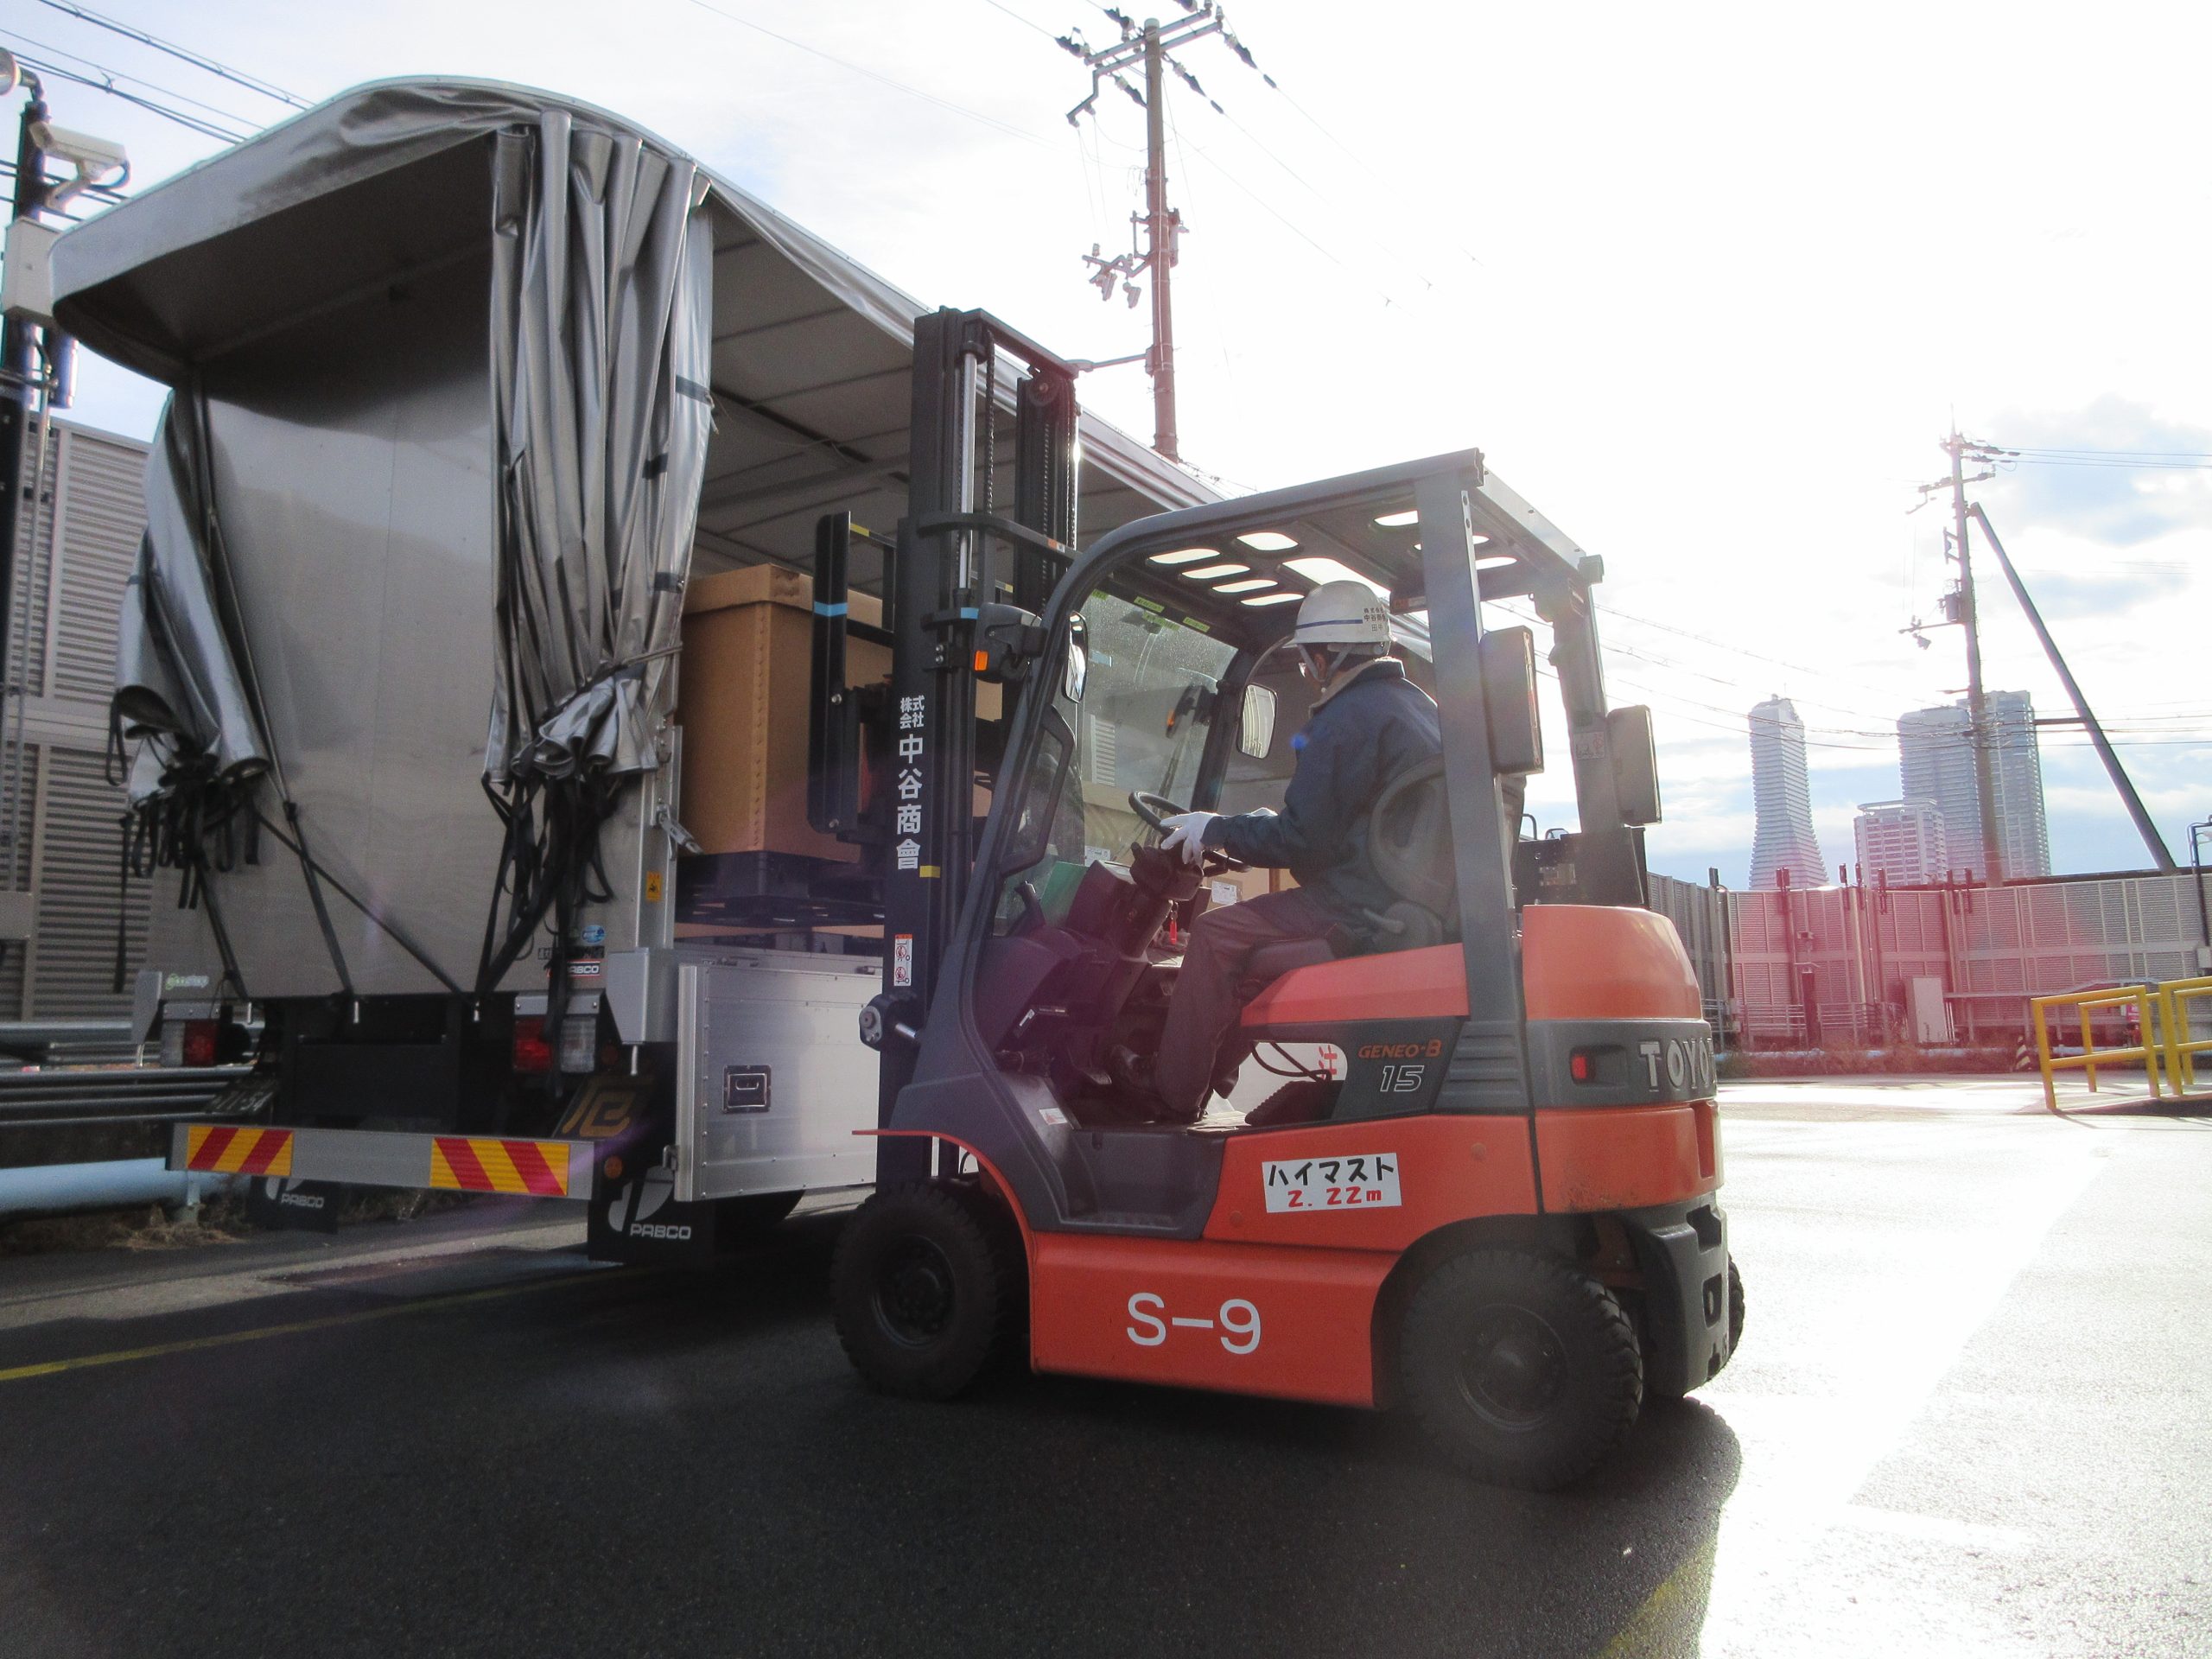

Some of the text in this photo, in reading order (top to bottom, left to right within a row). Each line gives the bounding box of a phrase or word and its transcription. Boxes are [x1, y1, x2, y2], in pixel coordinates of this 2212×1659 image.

[1380, 1065, 1425, 1092] 15
[1268, 1156, 1395, 1187] ハイマスト
[281, 1192, 325, 1209] PABCO
[630, 1224, 691, 1240] PABCO
